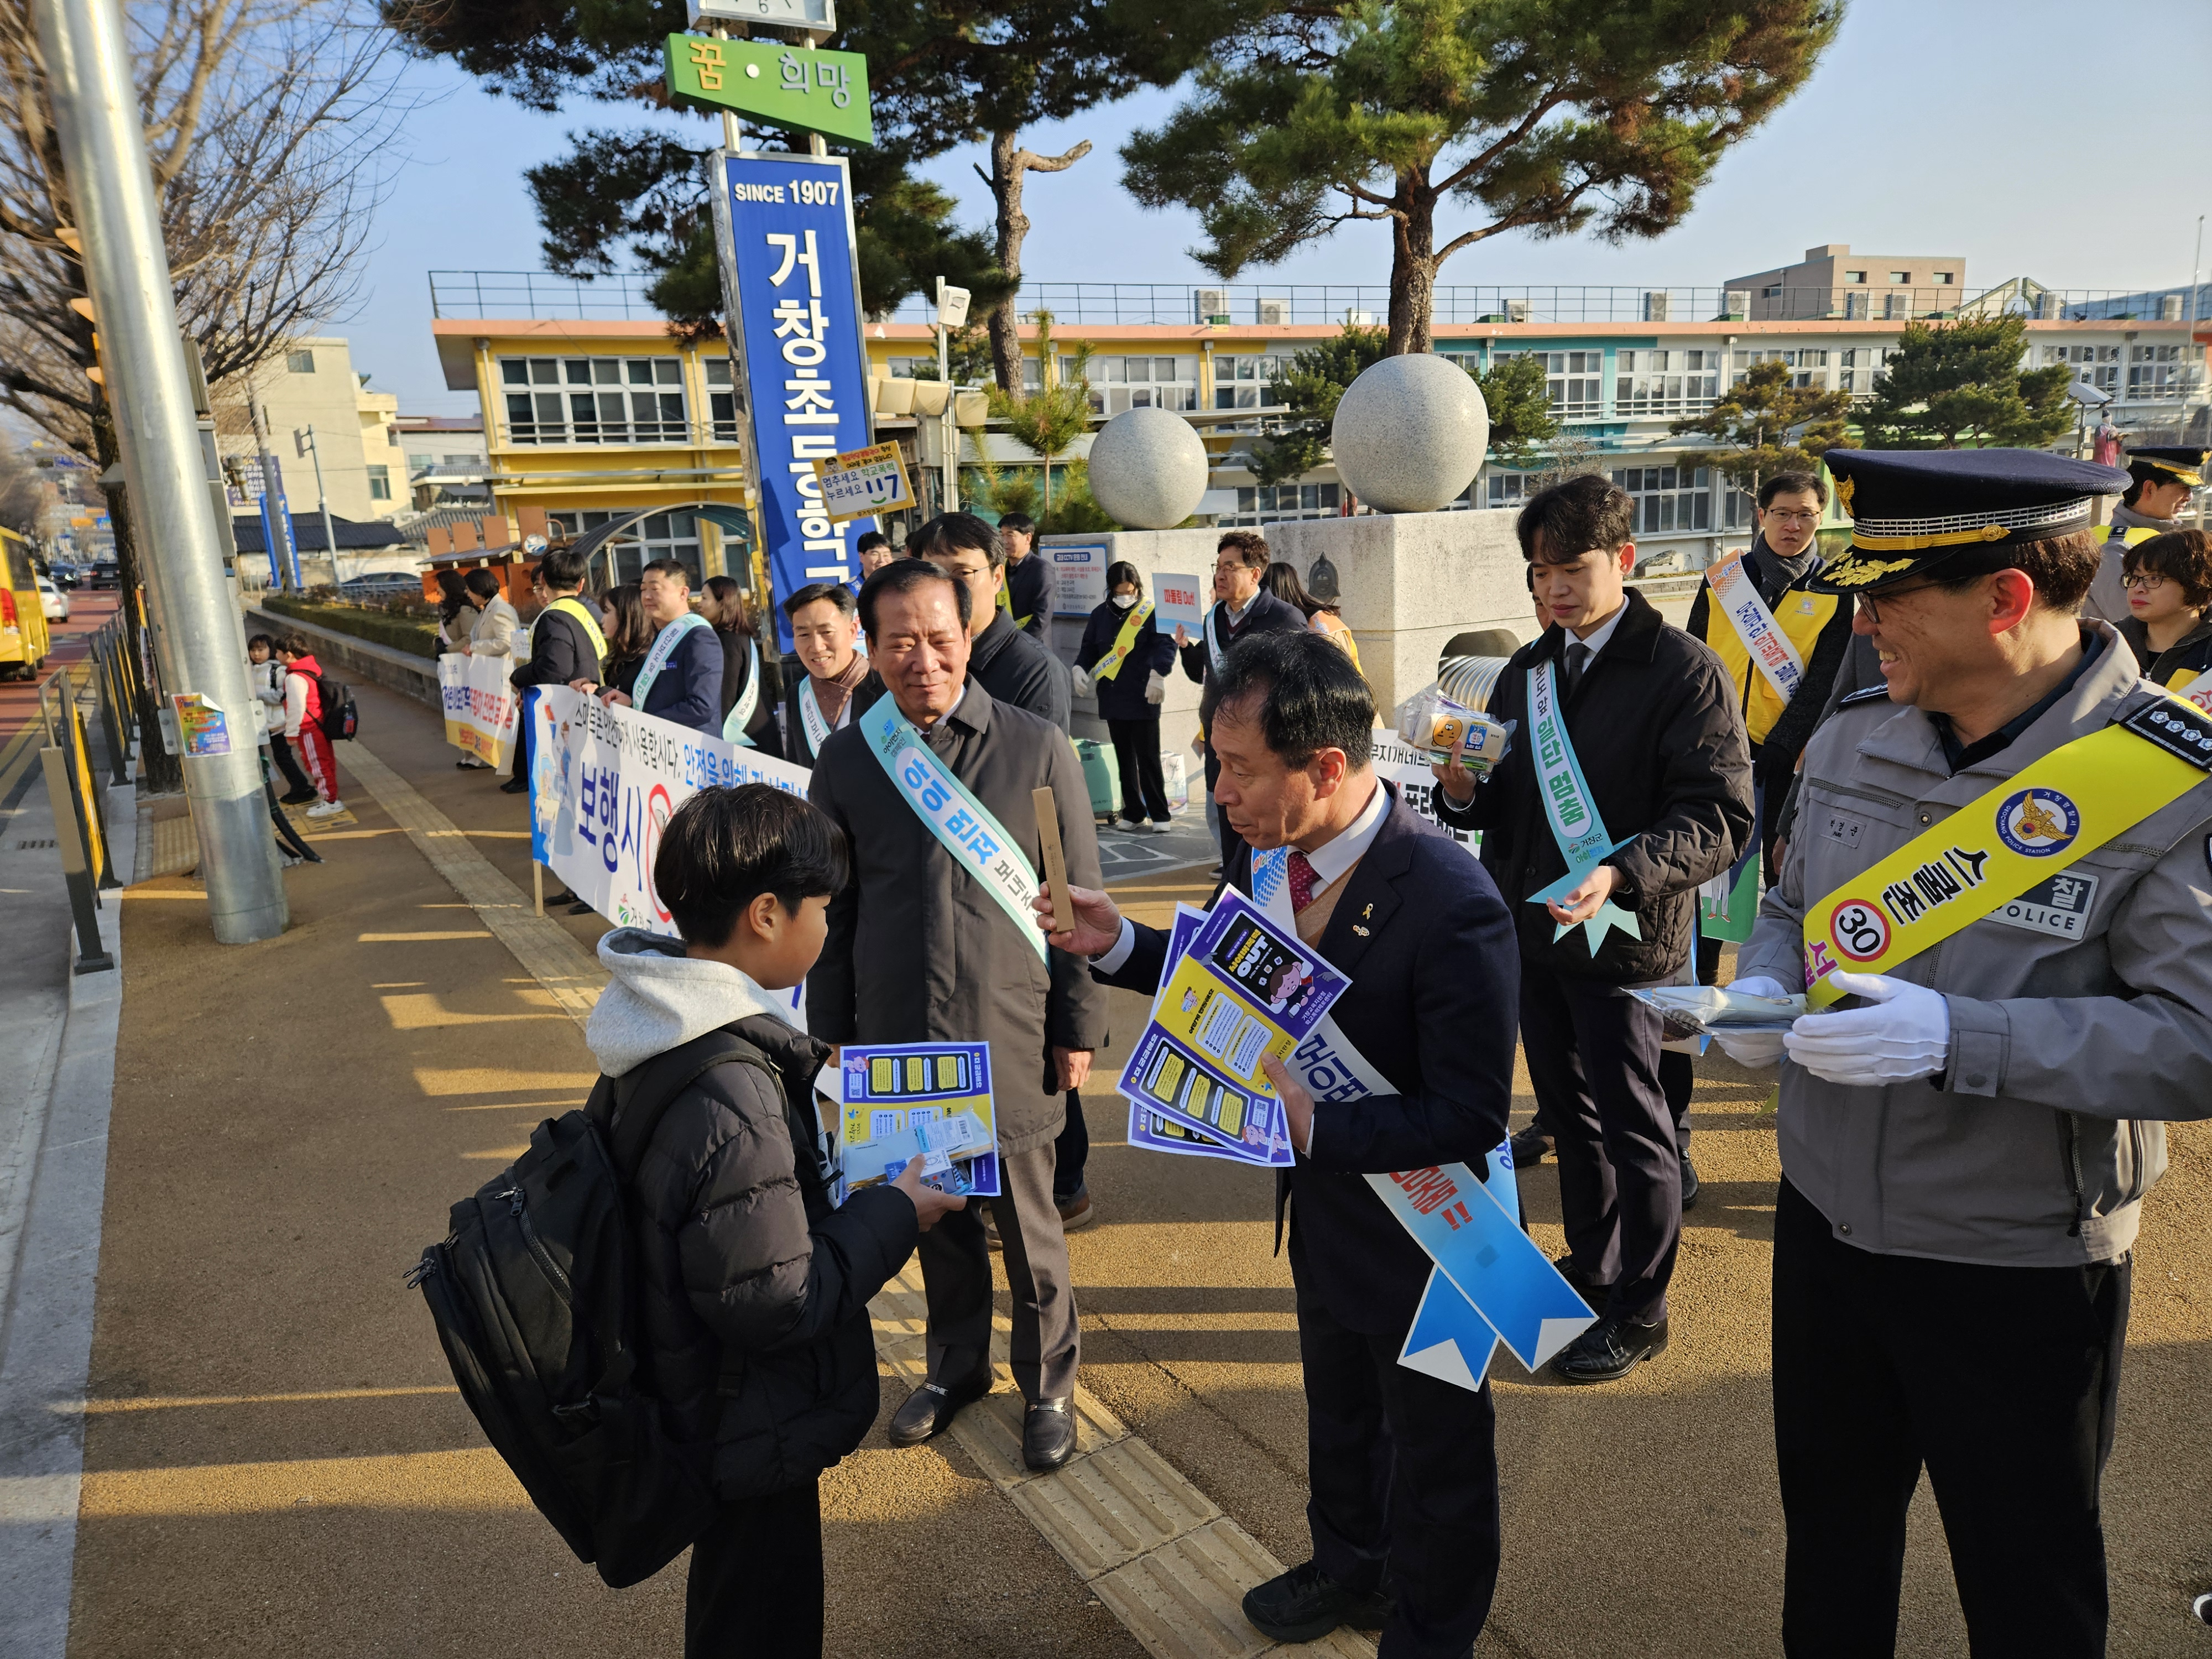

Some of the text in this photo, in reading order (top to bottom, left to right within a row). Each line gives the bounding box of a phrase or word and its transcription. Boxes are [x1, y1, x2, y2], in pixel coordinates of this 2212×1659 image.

[690, 41, 851, 108] 꿈 희망
[735, 180, 839, 206] SINCE 1907
[823, 462, 895, 488] 멈추세요 학교폭력
[827, 474, 898, 501] 누르세요 117
[1164, 589, 1195, 606] 따돌림 Out!
[1736, 601, 1764, 630] 무심코
[1748, 623, 1768, 638] 한
[1754, 632, 1790, 667] 학교폭력
[575, 701, 602, 740] 스마트폰
[1538, 697, 1548, 717] 앞
[883, 727, 903, 754] 아이먼저
[890, 737, 907, 758] 캠페인
[1537, 714, 1563, 770] 일단
[904, 758, 951, 812] 아이
[945, 808, 1000, 865] 먼저
[1549, 770, 1586, 827] 멈춤
[2000, 805, 2011, 834] GEOCHANG
[1580, 833, 1603, 848] 거창군
[2005, 836, 2022, 851] POLICE
[1882, 847, 1988, 925] 스쿨존
[2052, 878, 2084, 910] 찰
[1839, 907, 1881, 953] 30
[1228, 927, 1262, 974] 사이버폭력
[1237, 935, 1269, 978] OUT
[1301, 989, 1326, 1022] 거창교육지원청
[1305, 990, 1333, 1027] 학교폭력제로센터
[1133, 1067, 1142, 1077] 더
[1140, 1034, 1158, 1067] 궁금해요
